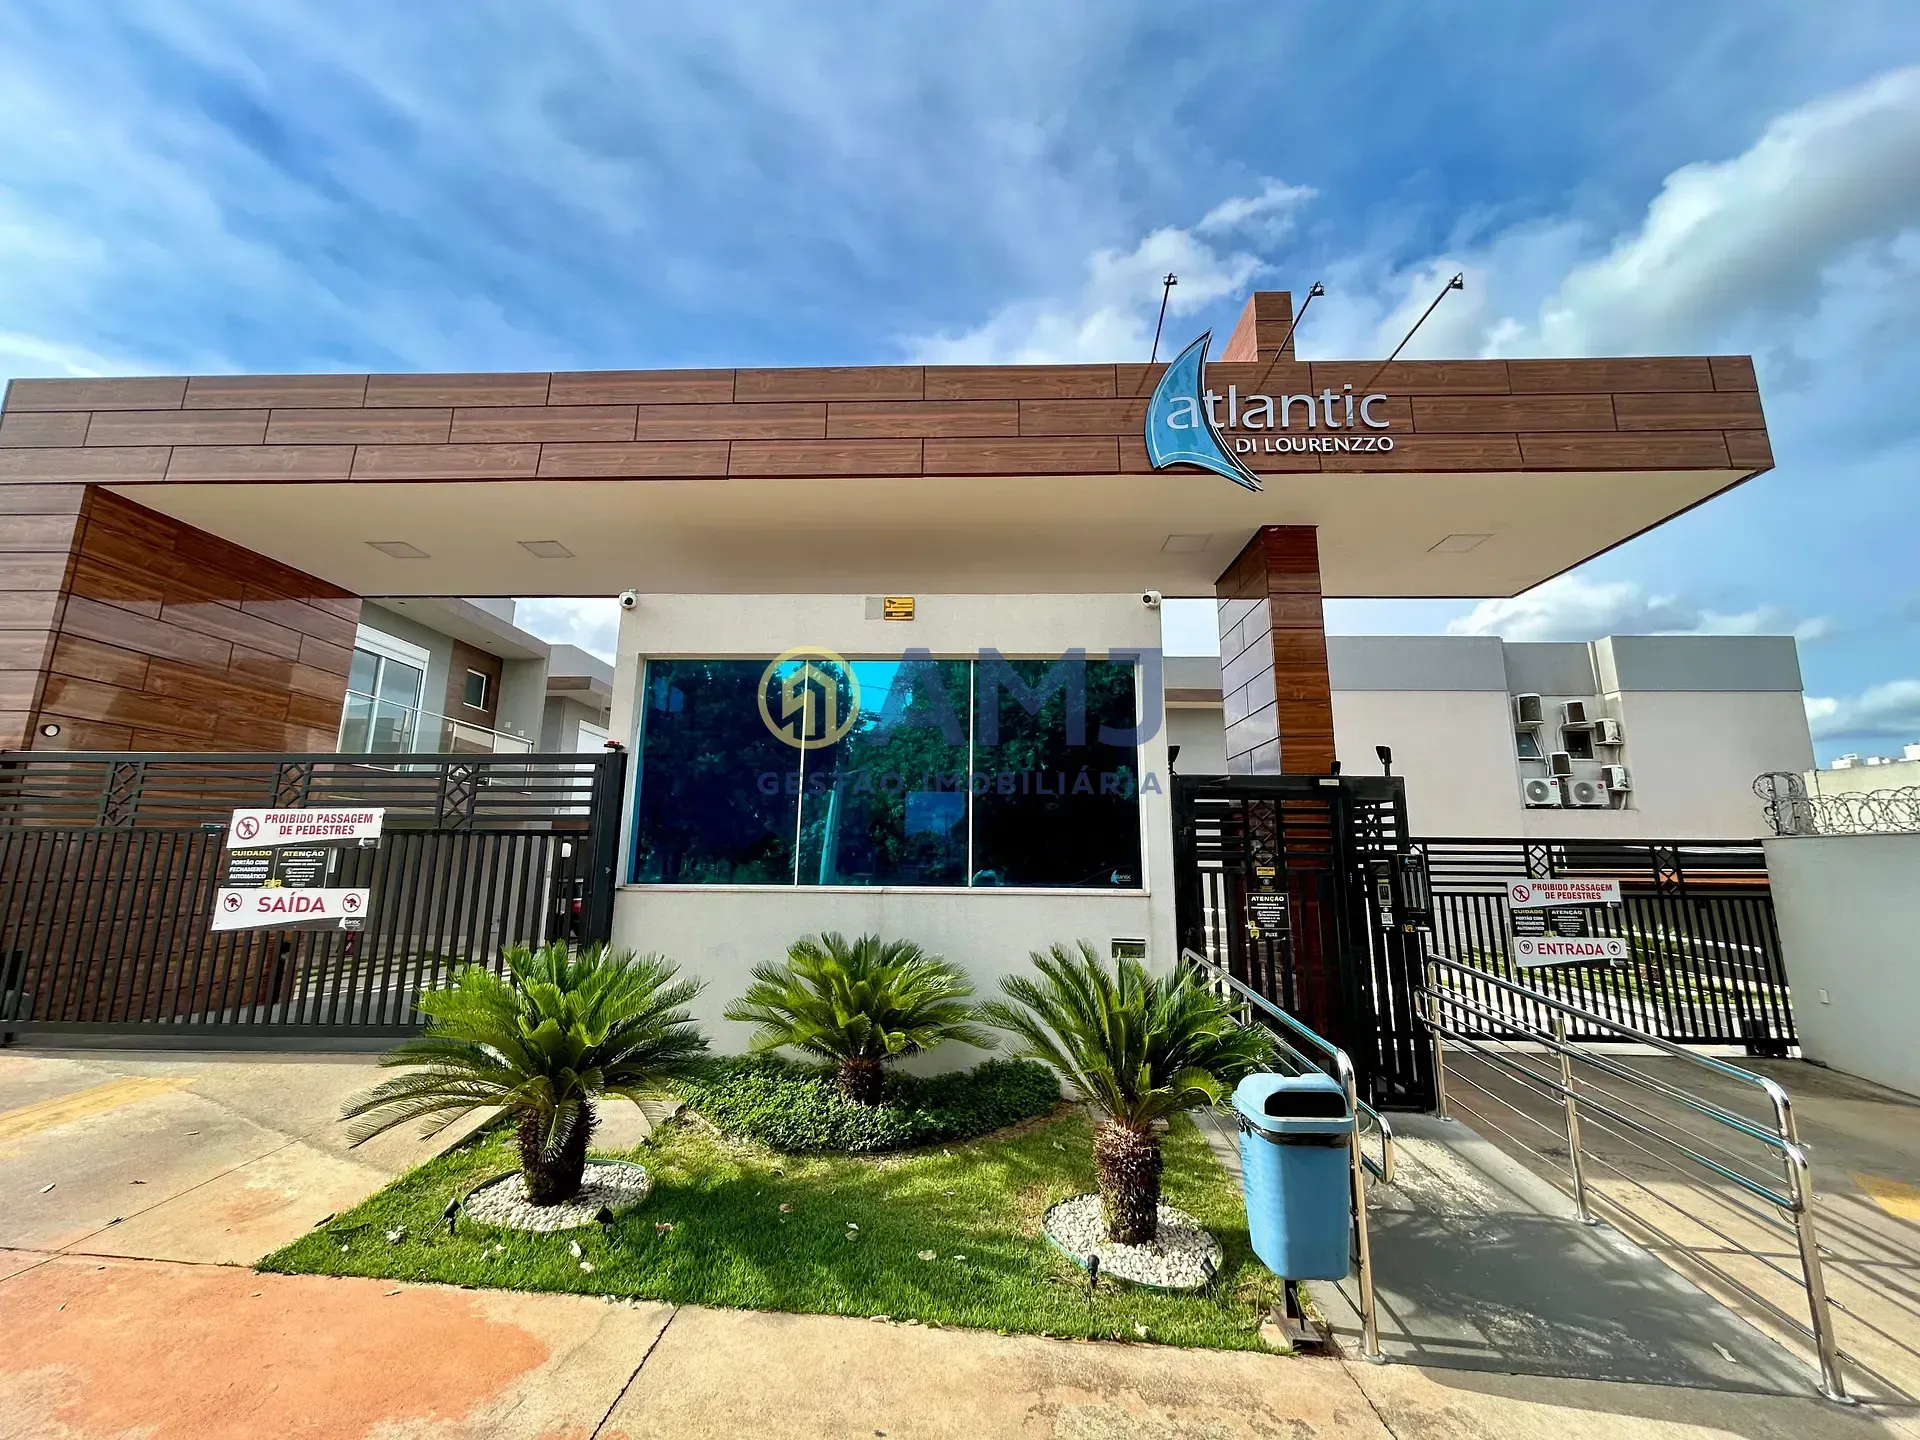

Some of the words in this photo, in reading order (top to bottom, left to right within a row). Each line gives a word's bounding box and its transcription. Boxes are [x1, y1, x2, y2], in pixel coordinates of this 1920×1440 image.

[1166, 383, 1390, 430] atlantic
[1236, 438, 1257, 453] DI
[1265, 436, 1394, 453] LOURENZZO
[264, 814, 313, 824] PROIBIDO
[316, 813, 374, 824] PASSAGEM
[279, 825, 293, 835] DE
[295, 825, 355, 835] PEDESTRES
[1557, 892, 1602, 900] PEDESTRES
[257, 892, 326, 913] SAÍDA
[1537, 943, 1605, 955] ENTRADA
